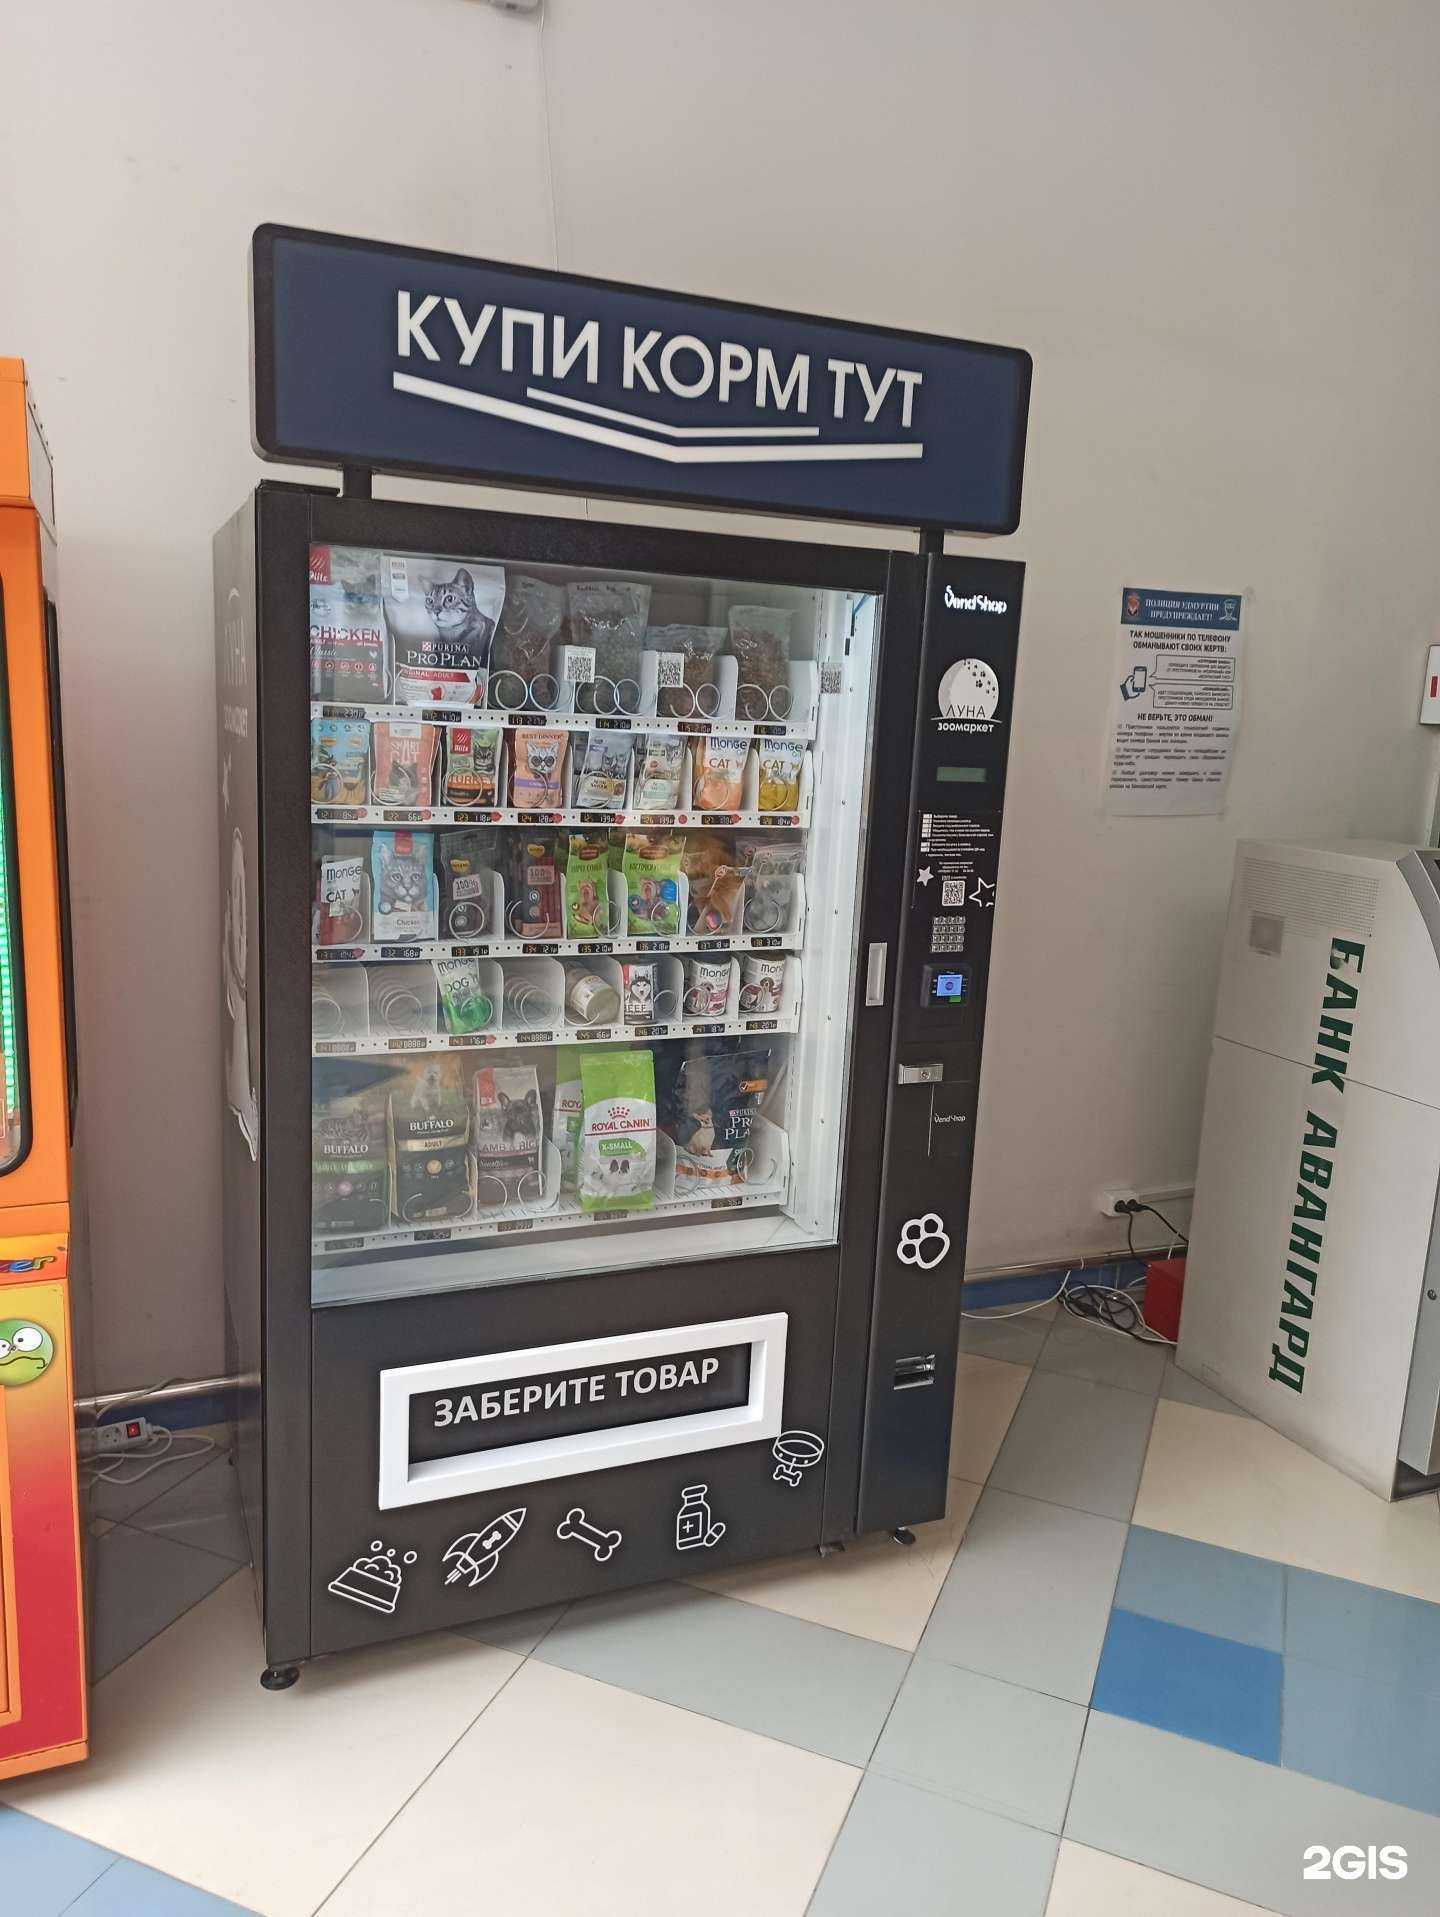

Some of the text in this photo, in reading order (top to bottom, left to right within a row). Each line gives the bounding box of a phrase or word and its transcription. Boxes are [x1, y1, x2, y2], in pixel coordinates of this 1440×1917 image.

[397, 290, 922, 427] КУПИ КОРМ ТУТ
[1145, 599, 1219, 612] ПОЛИЦИЯ УДМУРТИИ
[1150, 610, 1213, 621] ПРЕДУПРЕЖДАЕТ!
[310, 625, 380, 640] CHICKEN
[1130, 630, 1231, 643] ТАК МОШЕННИКИ ПО ТЕЛЕФОНУ
[432, 641, 468, 652] PURINA
[1133, 641, 1227, 653] ОБМАНЫВАЮТ СВОИХ ЖЕРТВ:
[407, 650, 482, 667] PRO PLAN
[947, 704, 986, 718] ЛУНА
[1138, 713, 1147, 721] НЕ
[1174, 714, 1188, 722] ЭТО
[1189, 714, 1214, 722] ОБМАН!
[937, 722, 994, 734] зоомаркет
[709, 757, 730, 769] CAT
[762, 760, 785, 771] CAT
[455, 879, 480, 891] 100%
[326, 888, 347, 903] CAT
[409, 1119, 454, 1132] BUFFALO
[592, 1118, 650, 1132] ROYAL CANIN
[724, 1127, 751, 1140] PLA
[323, 1144, 369, 1155] BUFFALO
[601, 1141, 633, 1151] X-SMALL
[1269, 937, 1366, 1395] БАНК АВАНГАРД
[434, 1357, 720, 1428] ЗАБЕРИТЕ ТОВАР
